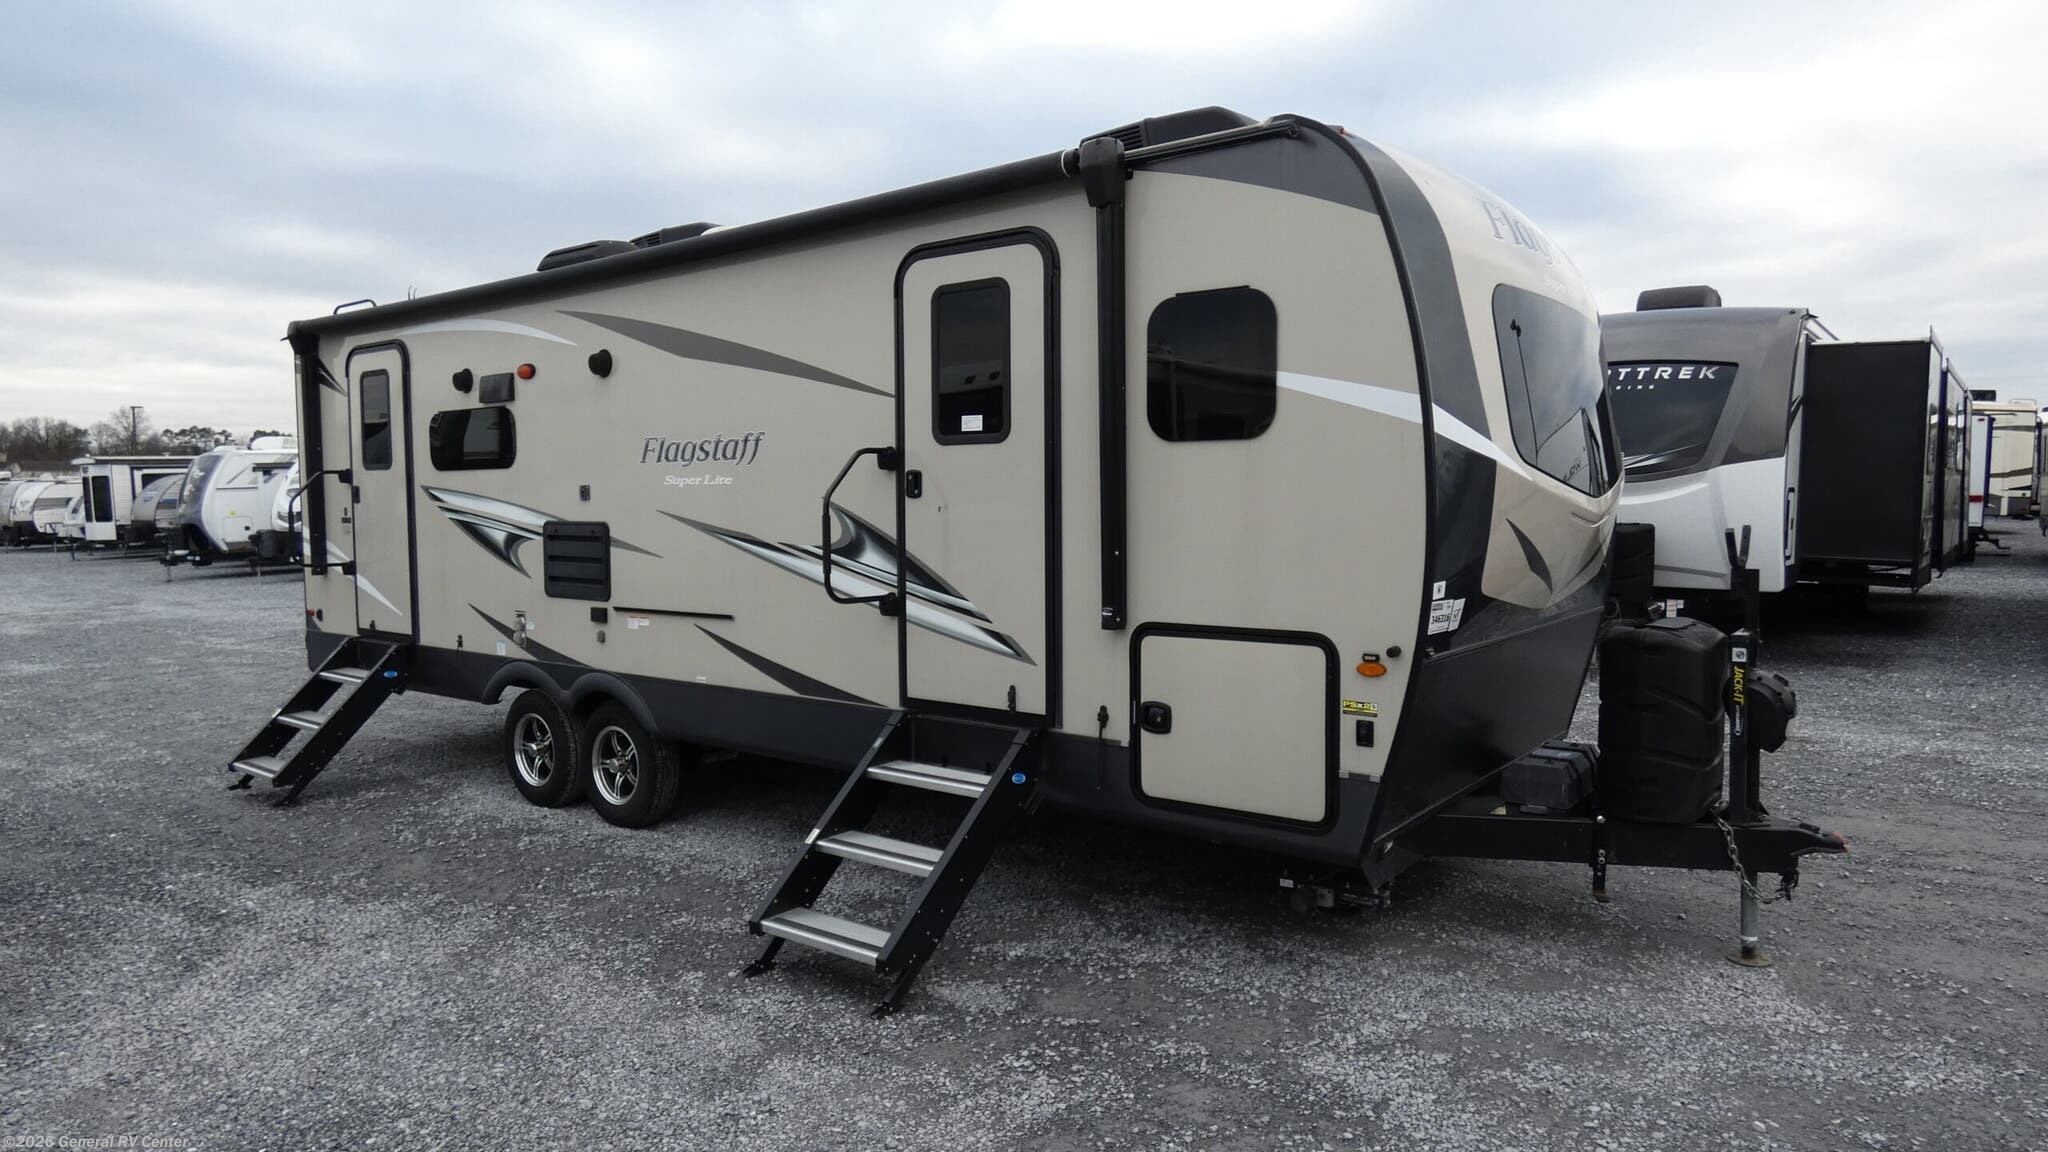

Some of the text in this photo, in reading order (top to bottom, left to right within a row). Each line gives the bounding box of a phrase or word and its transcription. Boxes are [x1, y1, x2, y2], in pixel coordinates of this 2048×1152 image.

[639, 431, 767, 468] Flagstaff
[663, 475, 733, 487] Super Lite
